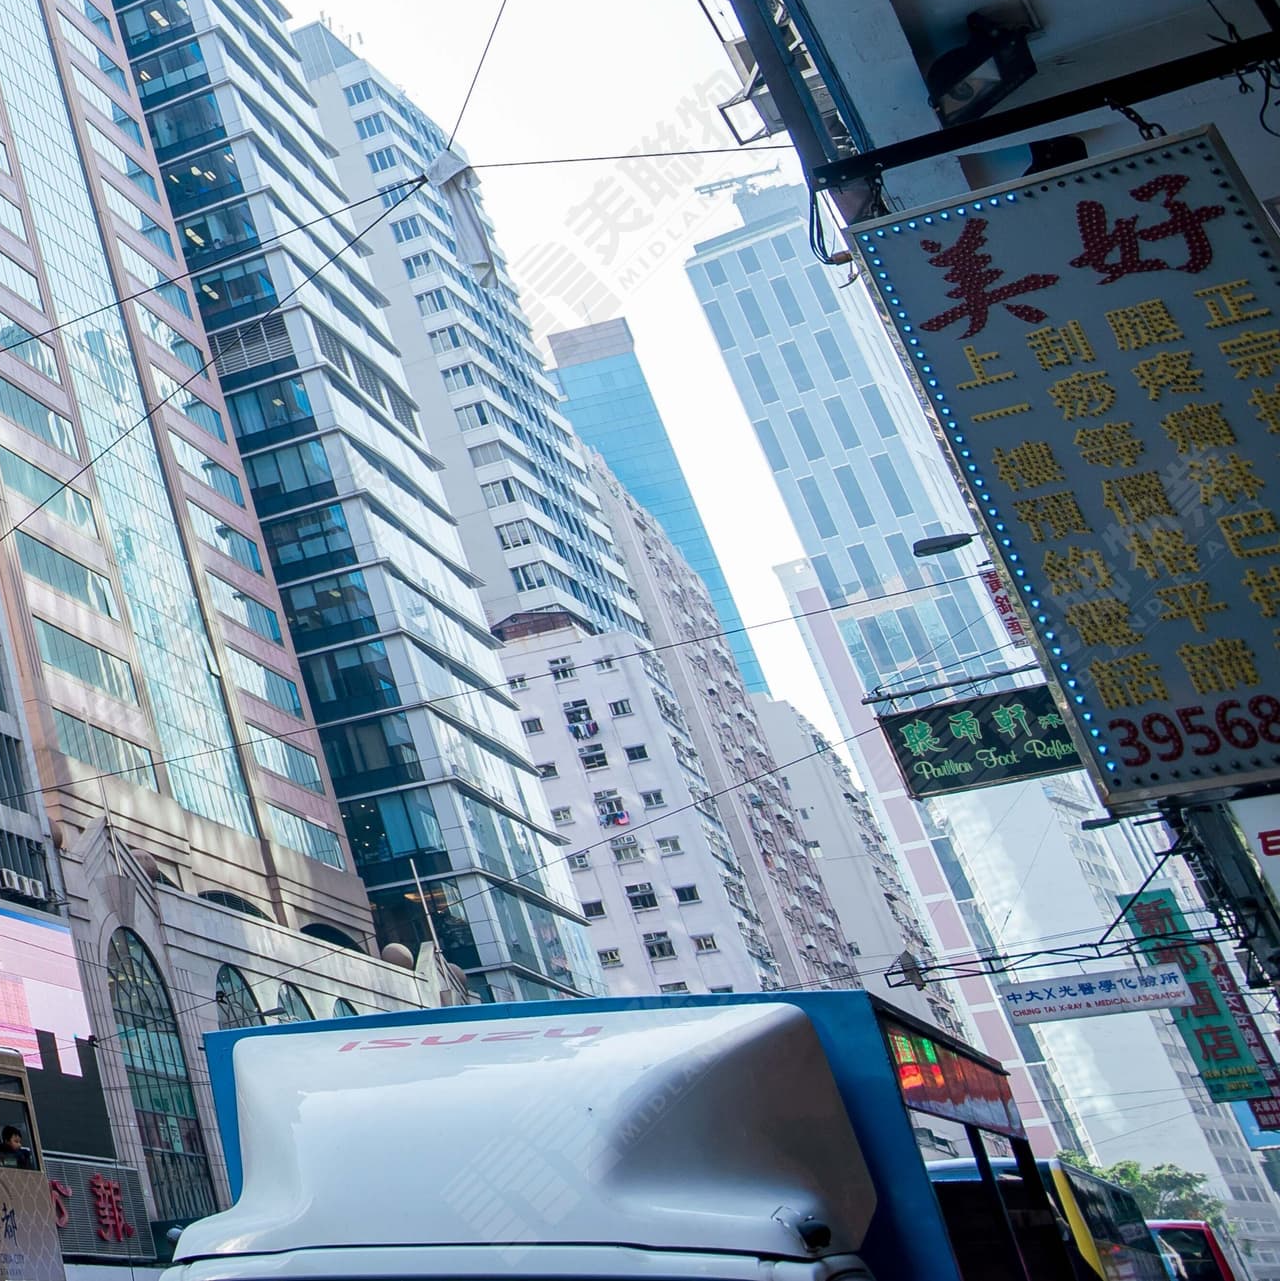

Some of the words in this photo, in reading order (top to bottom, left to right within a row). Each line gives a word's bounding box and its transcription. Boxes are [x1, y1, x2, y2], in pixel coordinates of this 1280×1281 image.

[975, 747, 1020, 769] Foot
[1013, 1007, 1042, 1018] CHUNG
[1044, 1005, 1057, 1014] TAI
[1059, 1002, 1083, 1013] X-RAY
[1086, 1001, 1092, 1009] &
[1094, 997, 1130, 1008] MEDICAL
[1133, 990, 1187, 1003] LABORATORY
[338, 1026, 604, 1053] ISUZU
